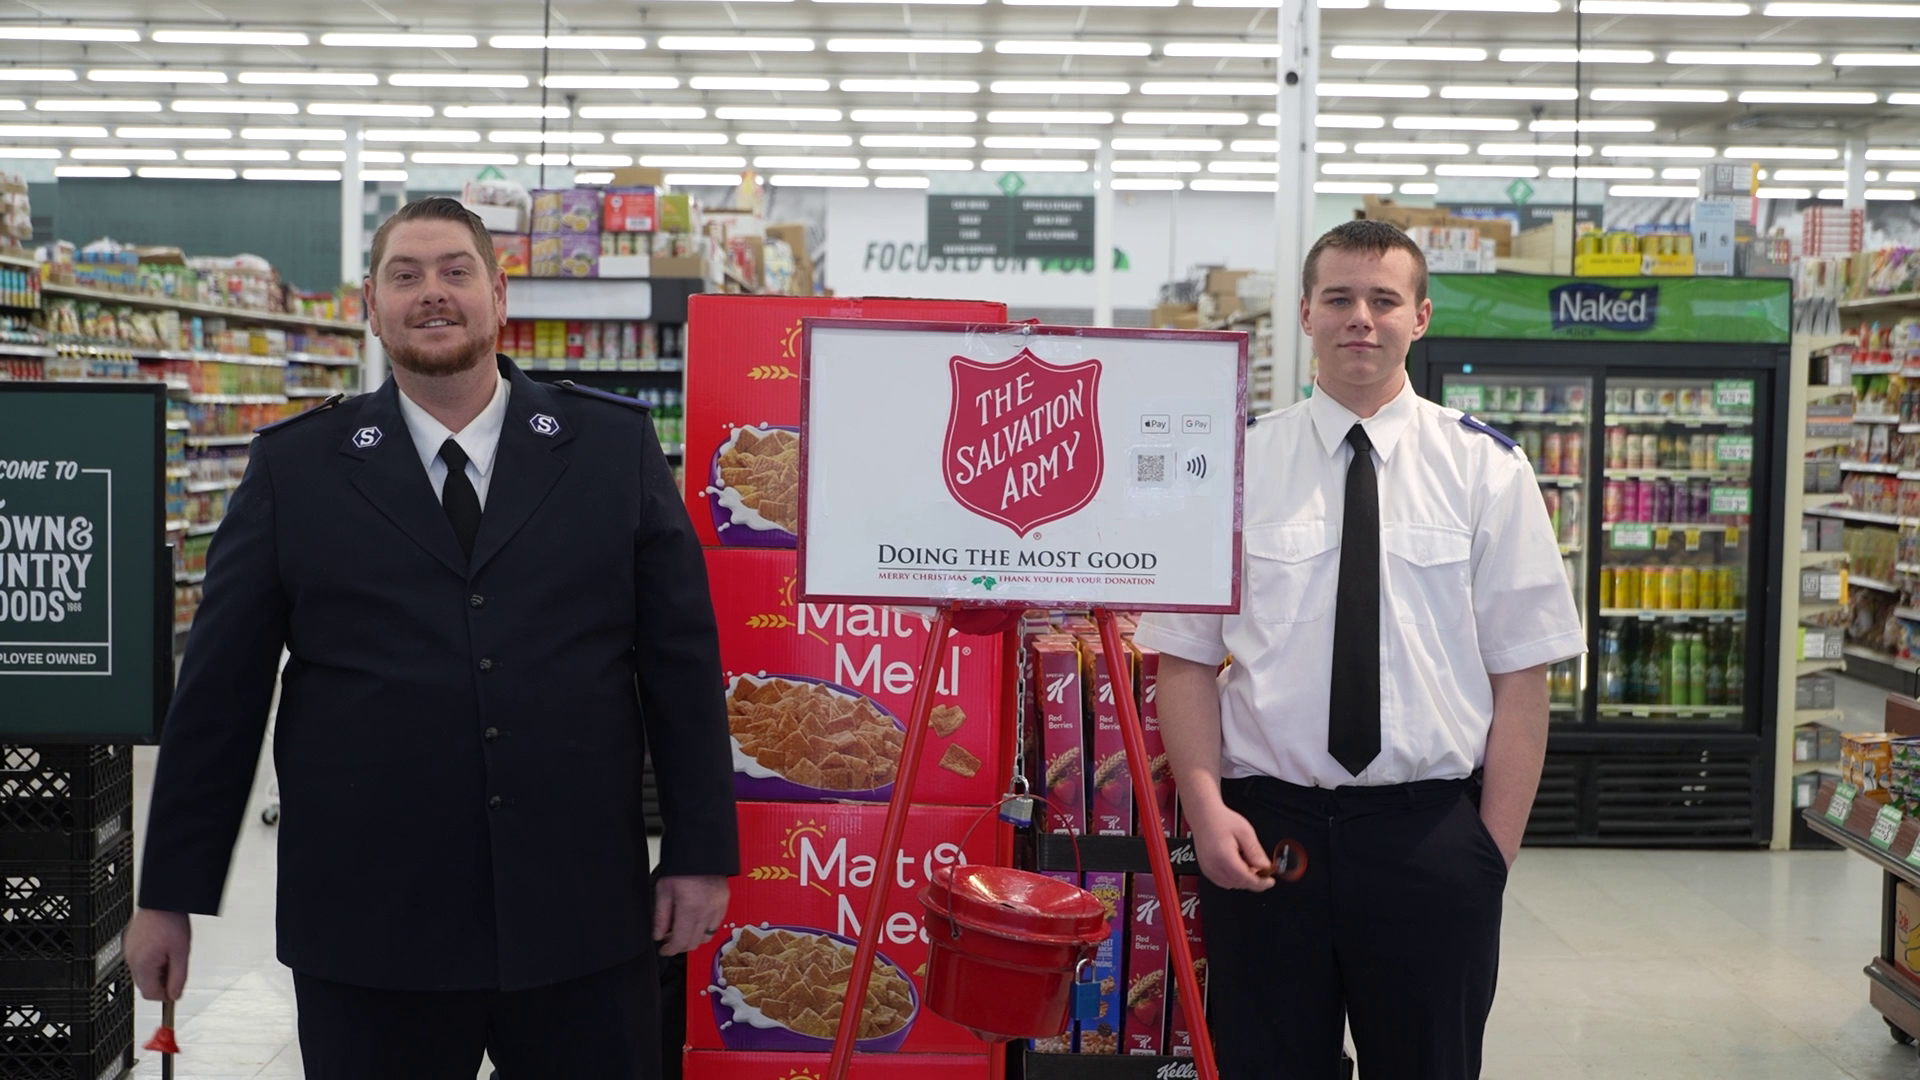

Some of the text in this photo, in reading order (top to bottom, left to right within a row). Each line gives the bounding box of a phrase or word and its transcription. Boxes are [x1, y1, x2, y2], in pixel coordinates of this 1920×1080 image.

[1560, 290, 1646, 322] Naked
[976, 372, 1035, 426] THE
[1151, 420, 1166, 430] Pay
[1195, 420, 1208, 429] Pay
[956, 379, 1084, 485] SALVATION
[55, 460, 79, 480] TO
[1001, 431, 1080, 511] ARMY
[965, 549, 1010, 566] THE
[1018, 550, 1081, 567] MOST
[1087, 552, 1157, 569] GOOD
[912, 573, 968, 581] CHRISTMAS
[998, 575, 1031, 583] THANK
[1056, 576, 1074, 584] FOR
[1105, 577, 1155, 585] DONATION
[46, 653, 97, 665] OWNED
[1046, 672, 1075, 704] K
[1048, 714, 1063, 722] Red
[1099, 715, 1114, 723] Red
[1048, 722, 1073, 730] Berries
[1135, 934, 1150, 943] Red
[1135, 943, 1160, 951] Berries
